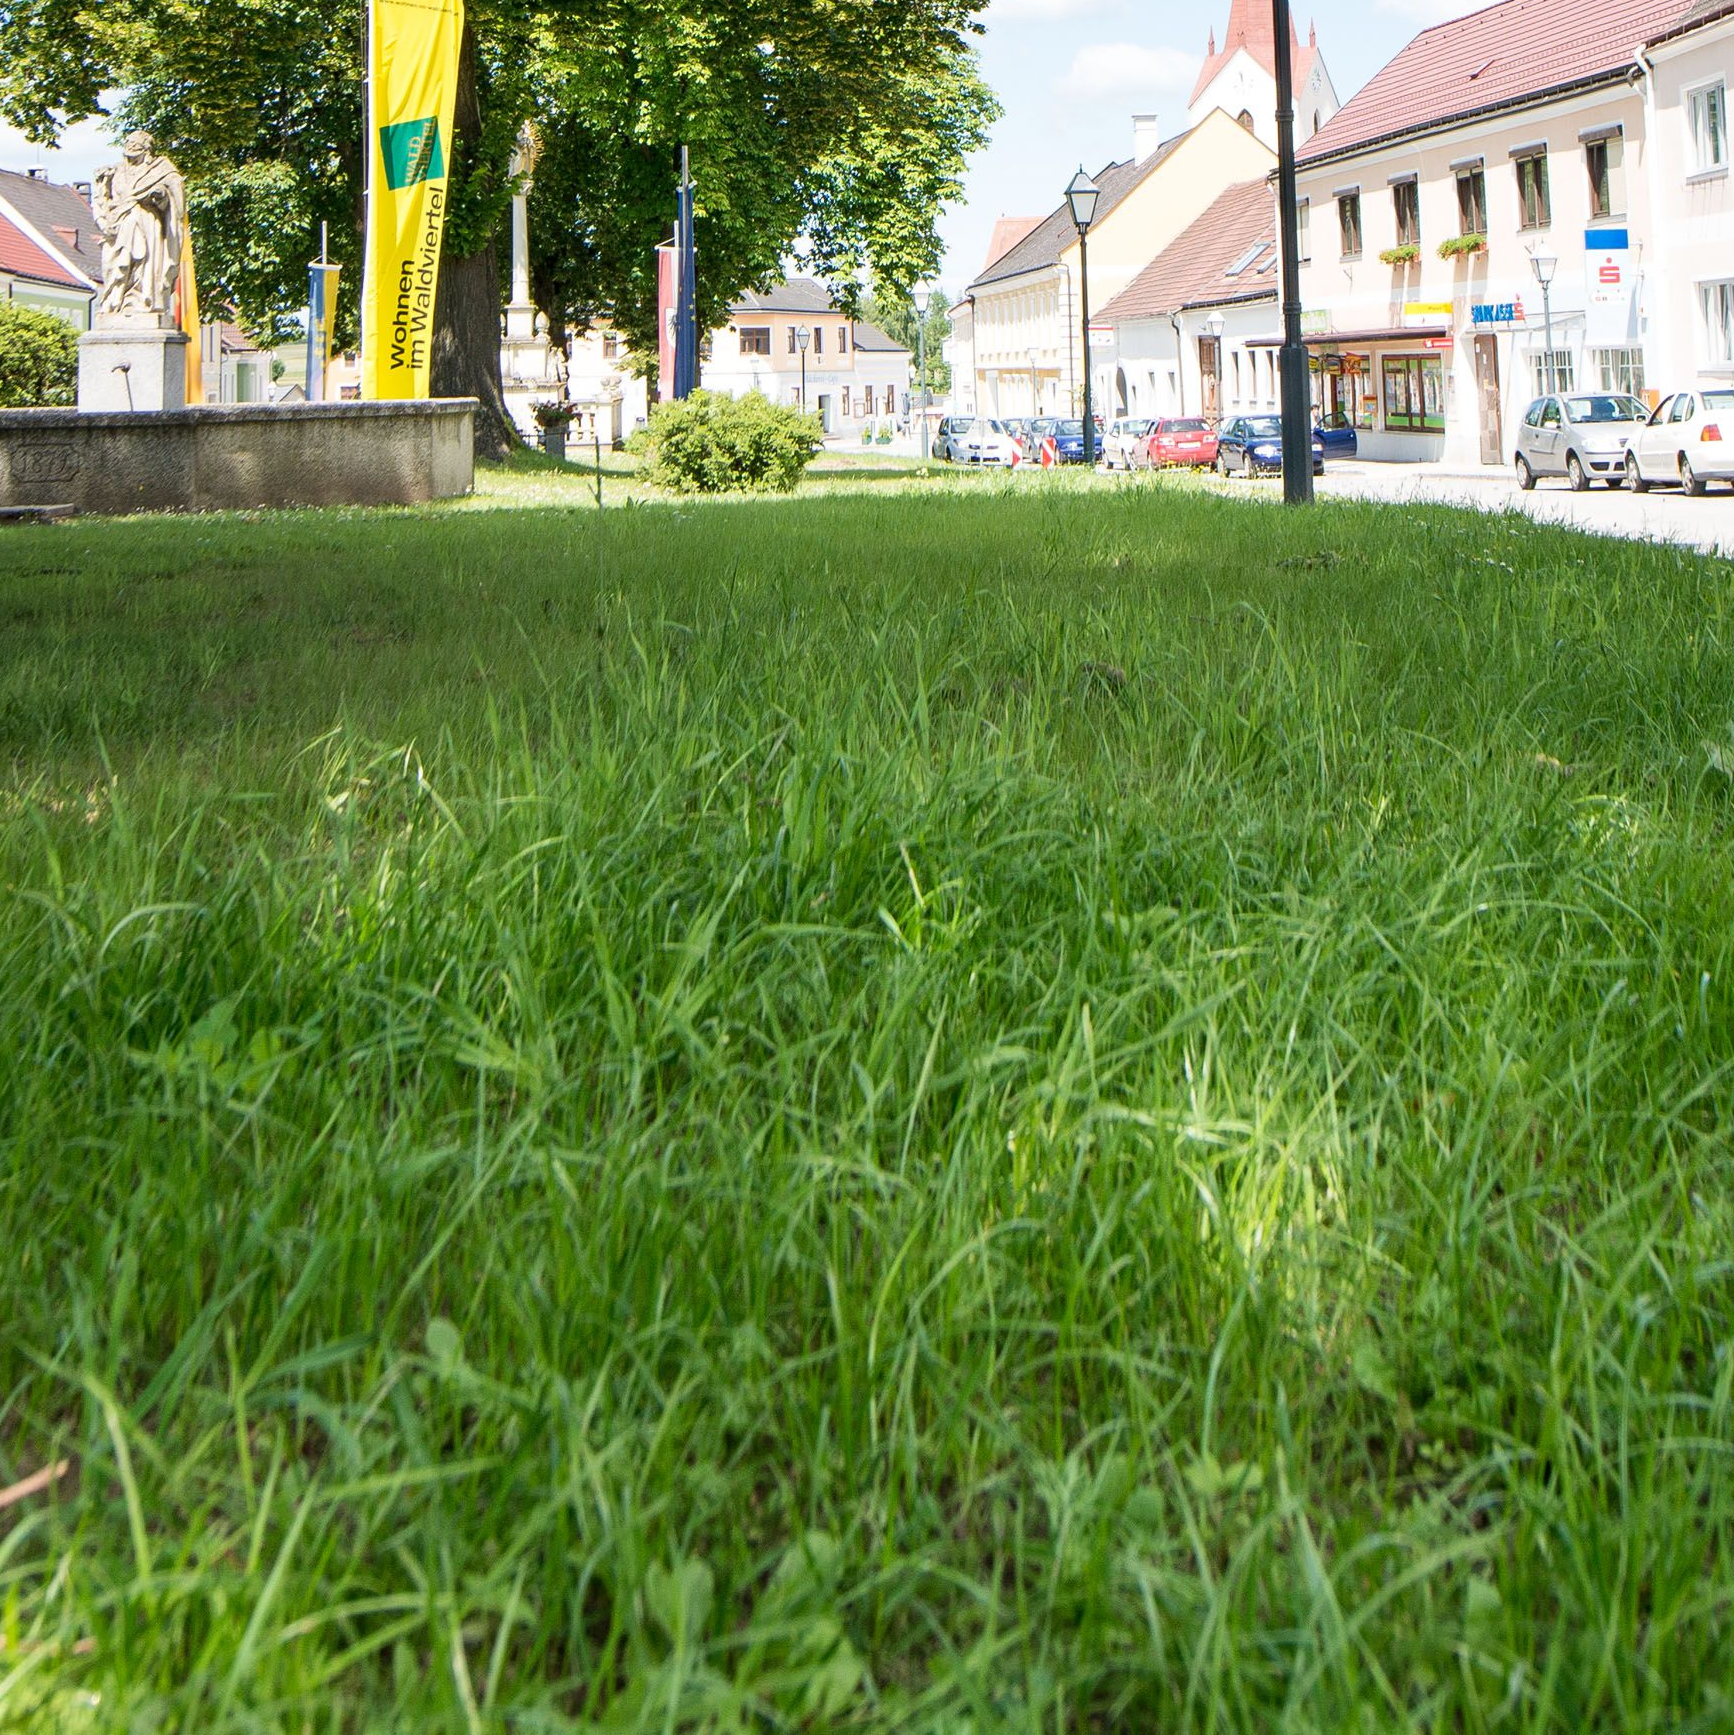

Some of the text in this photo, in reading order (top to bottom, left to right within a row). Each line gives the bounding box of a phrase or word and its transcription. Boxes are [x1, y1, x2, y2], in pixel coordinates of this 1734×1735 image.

[405, 136, 421, 183] WALD
[390, 259, 414, 370] Wohnen
[407, 187, 443, 369] im Waldviertel
[20, 451, 69, 474] 1879
